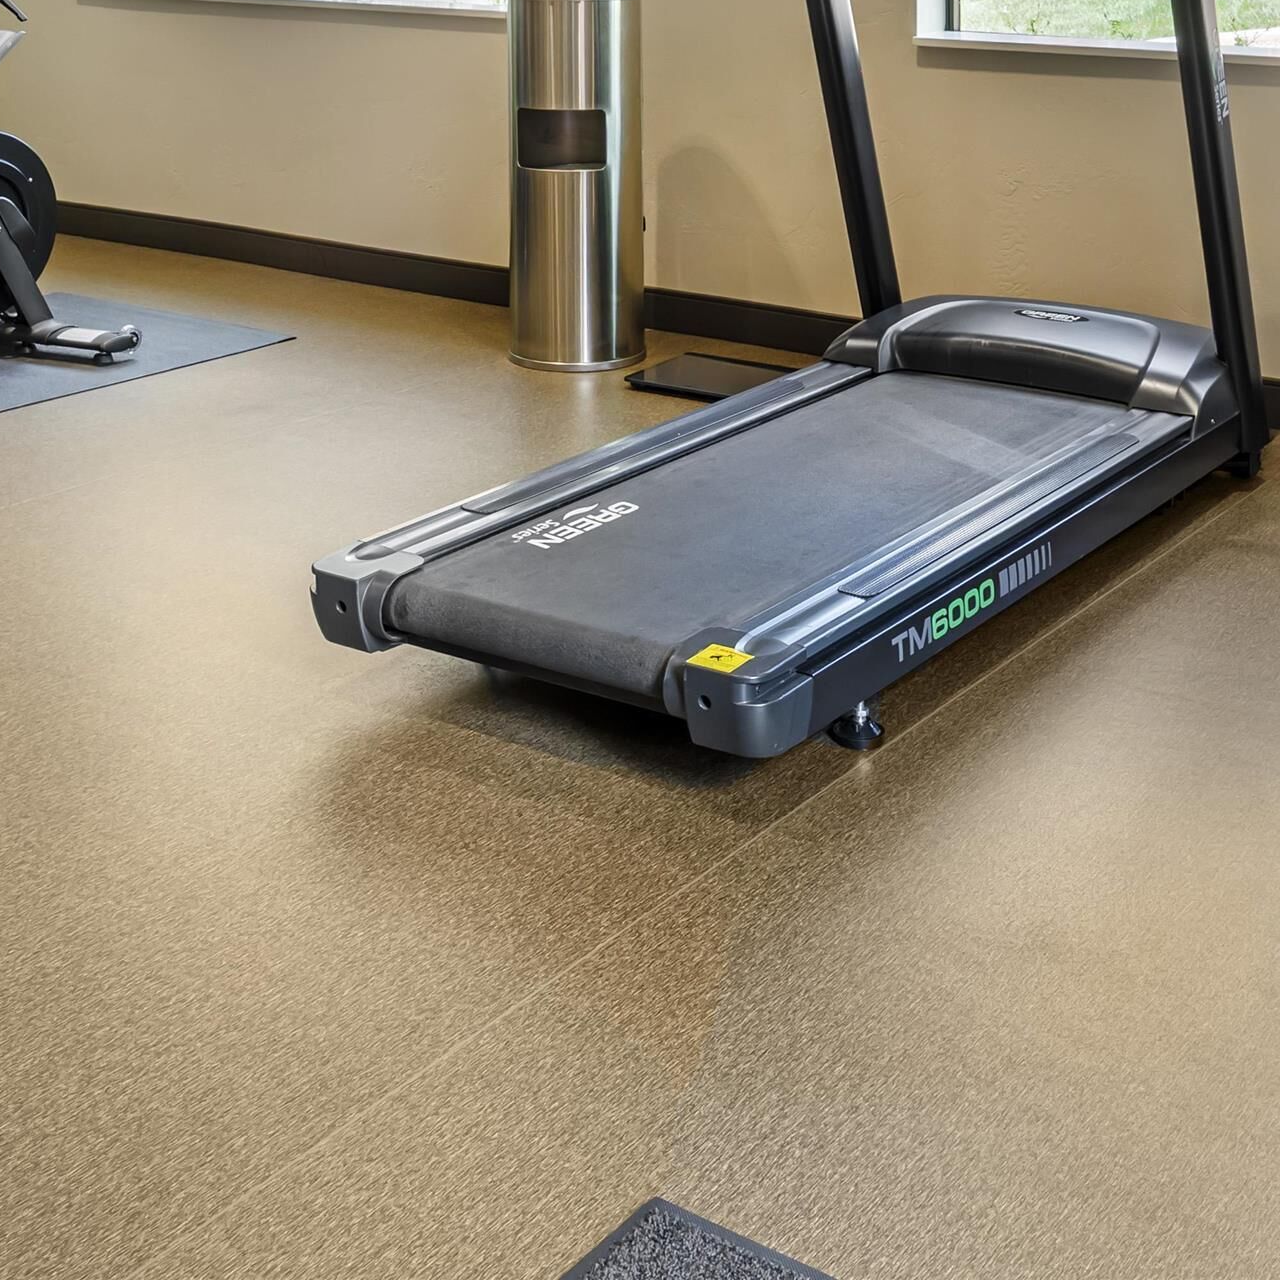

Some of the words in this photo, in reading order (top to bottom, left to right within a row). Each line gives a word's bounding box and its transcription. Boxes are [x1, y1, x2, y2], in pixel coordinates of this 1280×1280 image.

[511, 519, 561, 540] Series
[527, 501, 640, 549] GREEN
[891, 578, 995, 663] TM6000
